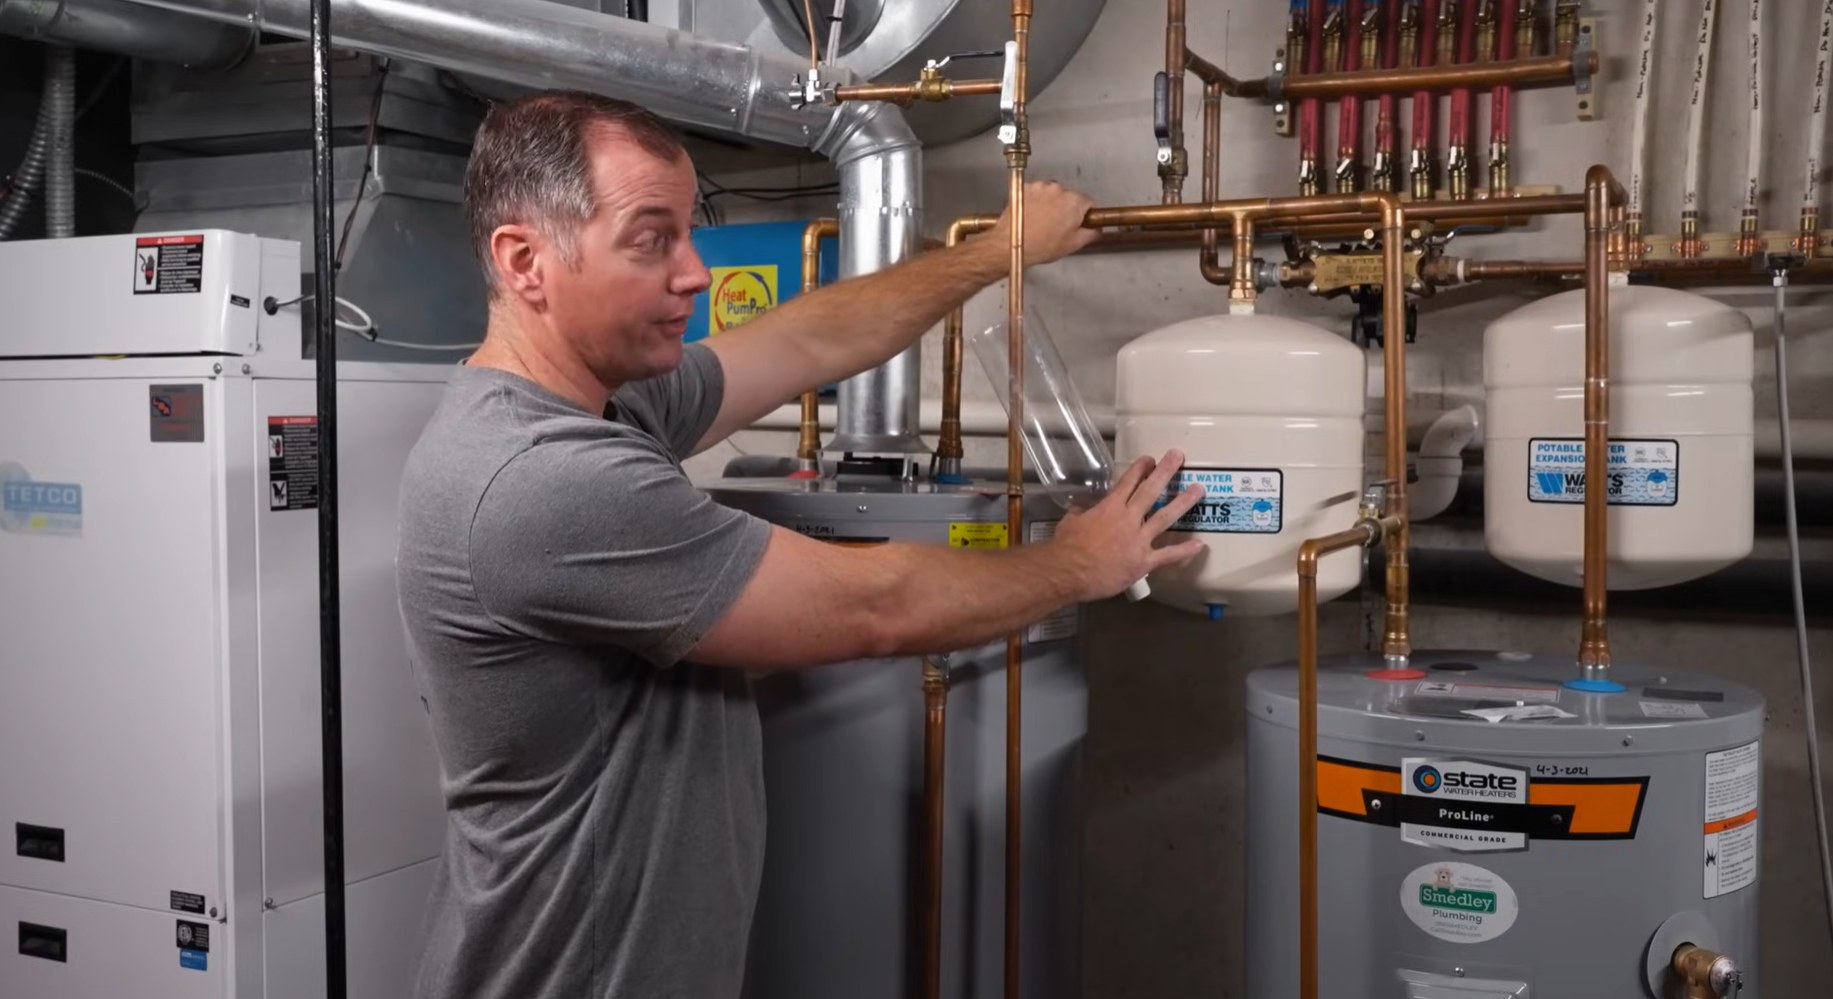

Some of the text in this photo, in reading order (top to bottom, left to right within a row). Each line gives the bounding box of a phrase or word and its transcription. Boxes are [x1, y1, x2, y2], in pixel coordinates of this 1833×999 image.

[723, 289, 747, 302] Heat
[1537, 444, 1583, 453] POTABLE
[1536, 454, 1586, 463] EXPANSIO
[1196, 474, 1232, 483] WATER
[1205, 484, 1234, 493] TANK
[1565, 487, 1623, 495] REGOR
[8, 485, 77, 505] TETCO
[1190, 503, 1231, 517] ATTS
[1536, 764, 1589, 776] 4-3-2021
[1443, 771, 1517, 791] state
[1443, 787, 1517, 799] WATER HEATERS
[1420, 830, 1507, 843] COMMERCIAL GRADE
[1422, 888, 1493, 911] Smedley
[1432, 909, 1483, 925] Plumbing
